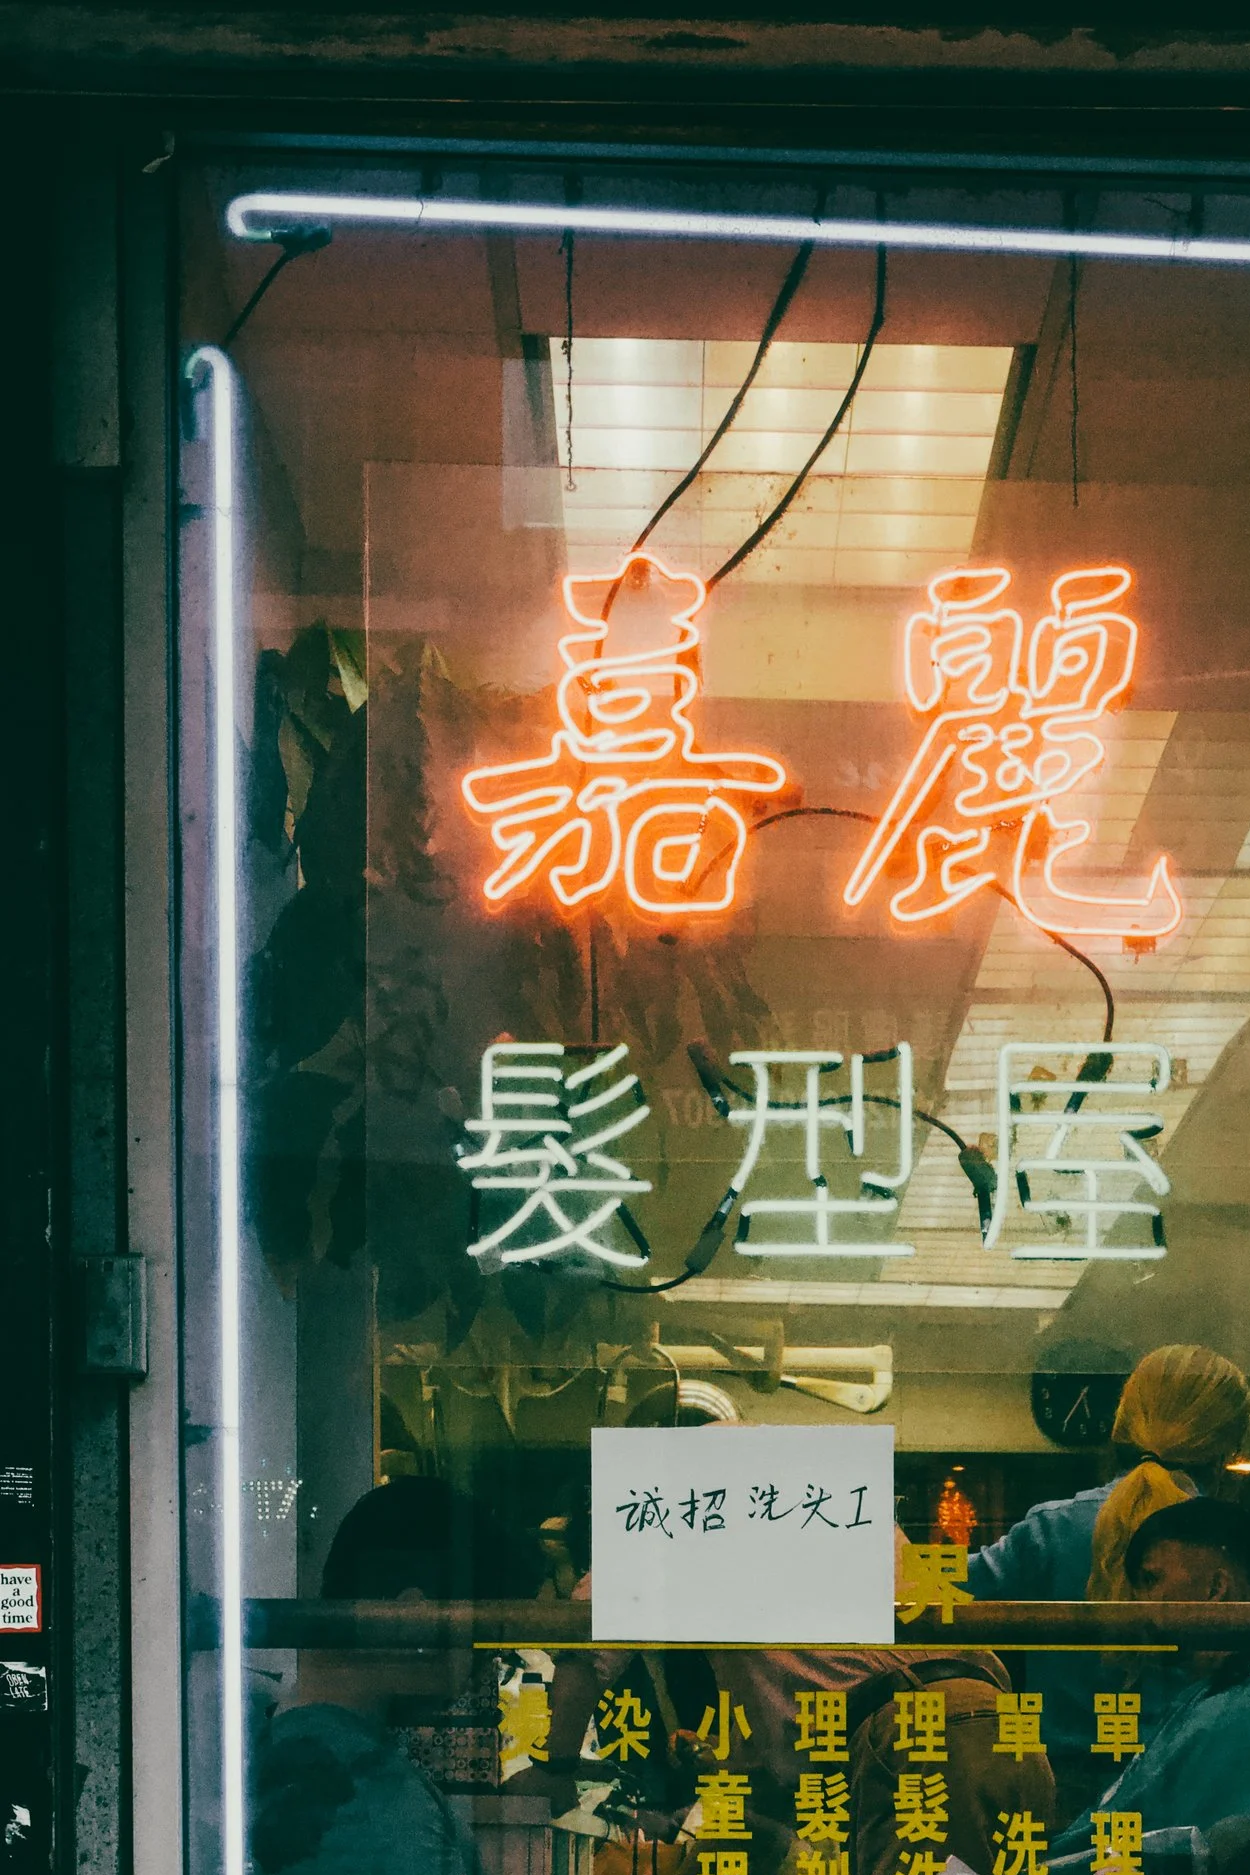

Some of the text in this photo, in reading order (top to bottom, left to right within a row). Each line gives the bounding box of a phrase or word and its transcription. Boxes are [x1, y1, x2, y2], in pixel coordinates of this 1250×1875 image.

[462, 551, 1182, 936] 嘉麗
[456, 1041, 1173, 1268] 髮型屋
[0, 1573, 32, 1585] have
[12, 1588, 21, 1597] a
[0, 1595, 34, 1610] good
[2, 1611, 33, 1624] time
